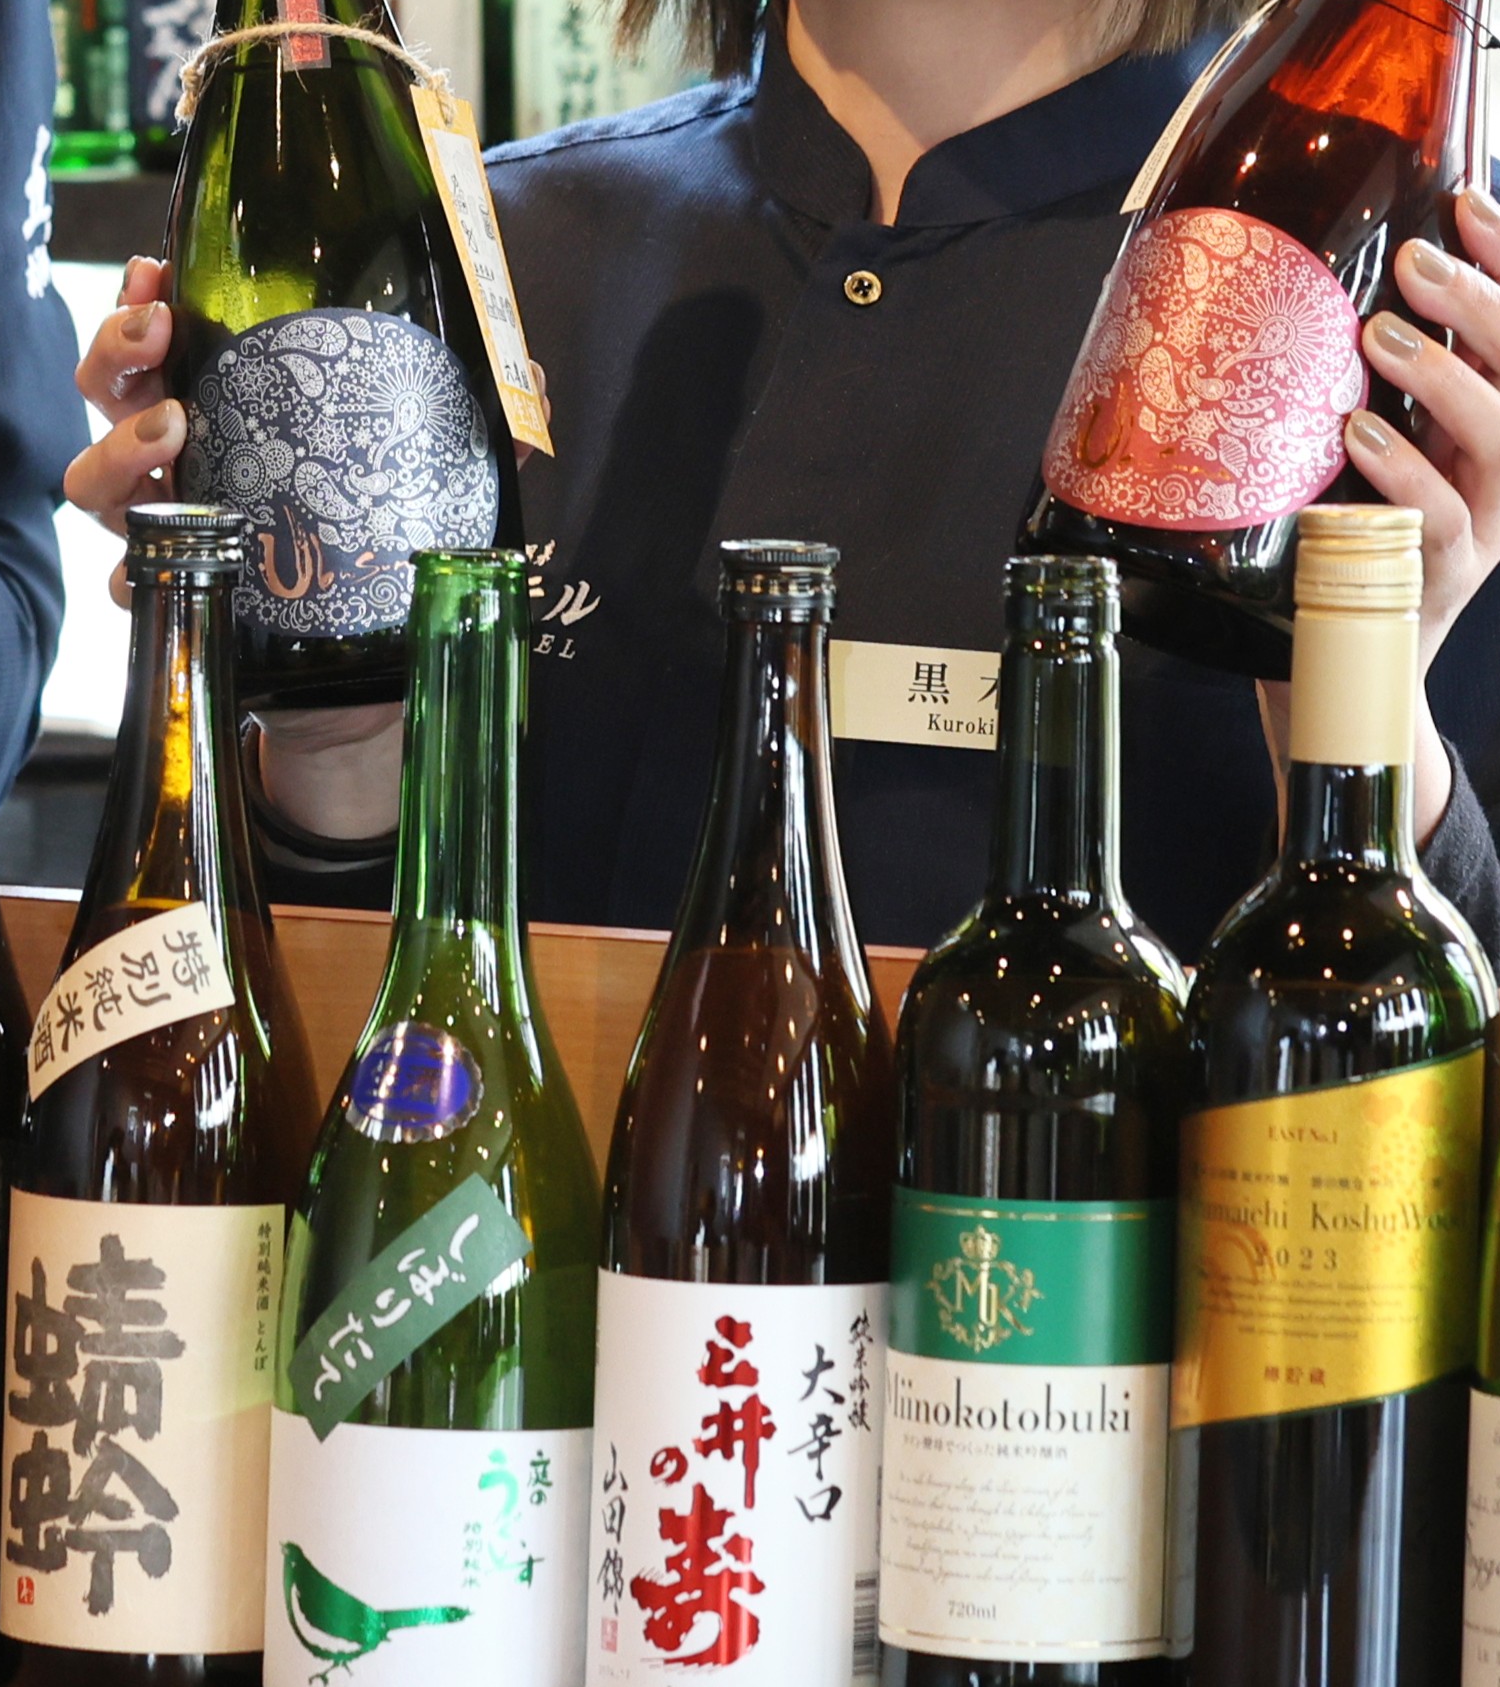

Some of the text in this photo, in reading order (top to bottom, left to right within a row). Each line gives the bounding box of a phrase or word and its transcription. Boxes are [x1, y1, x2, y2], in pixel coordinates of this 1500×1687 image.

[927, 712, 995, 737] Kuroki
[30, 929, 213, 1074] 特別純米酒
[253, 1221, 274, 1374] 特別純米酒 とんぼ
[313, 1212, 482, 1402] しぼりたて
[526, 1448, 554, 1506] 庭の
[629, 1314, 779, 1668] 三井の寿
[785, 1344, 849, 1524] 大辛口
[597, 1440, 629, 1617] 山田錦
[948, 1600, 998, 1621] 720ml
